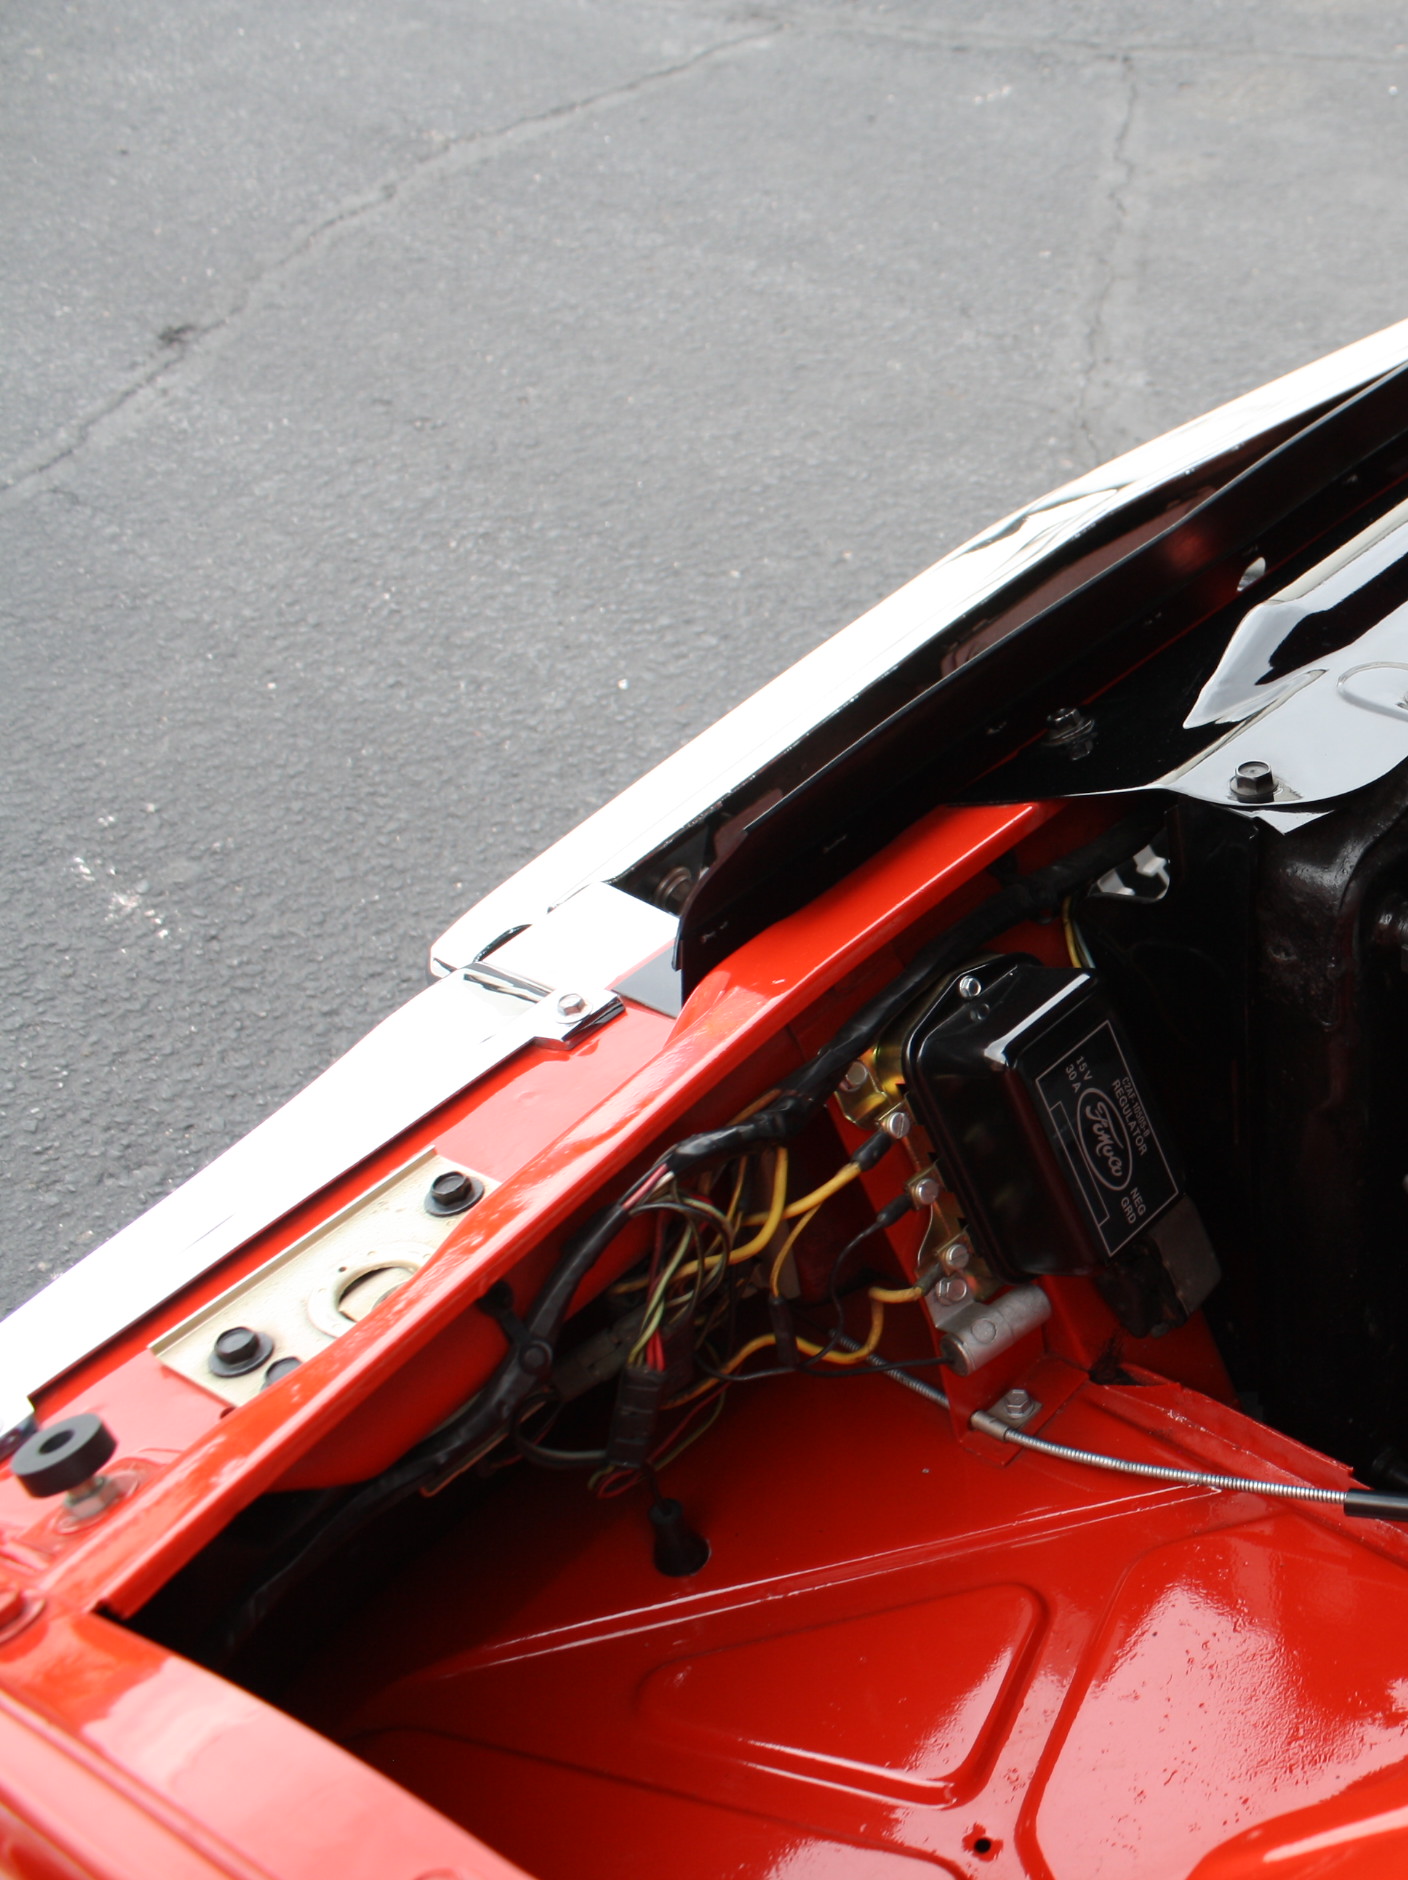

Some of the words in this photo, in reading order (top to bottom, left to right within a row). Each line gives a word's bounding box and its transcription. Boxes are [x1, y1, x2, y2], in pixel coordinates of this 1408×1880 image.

[1065, 1064, 1078, 1081] 30
[1072, 1081, 1082, 1092] A
[1076, 1055, 1088, 1071] 15
[1083, 1070, 1093, 1080] V
[1111, 1079, 1148, 1156] REGULATOR
[1120, 1196, 1137, 1224] GRD
[1129, 1187, 1147, 1216] NEG
